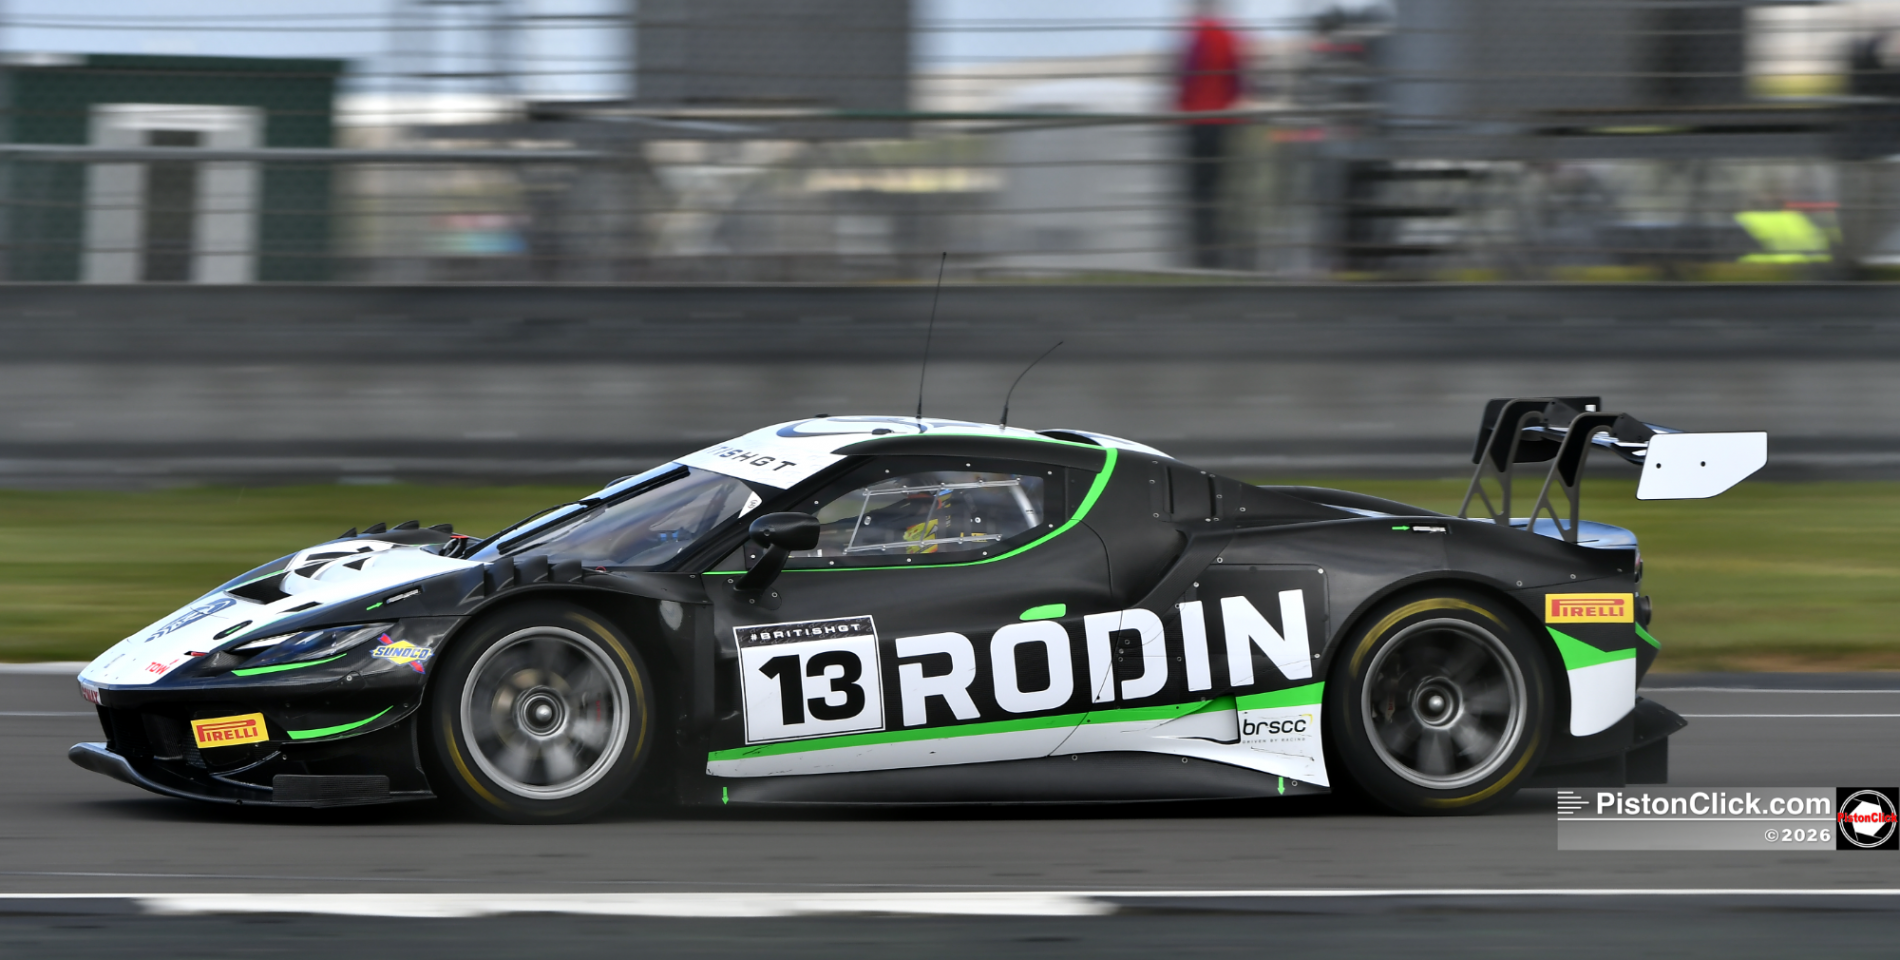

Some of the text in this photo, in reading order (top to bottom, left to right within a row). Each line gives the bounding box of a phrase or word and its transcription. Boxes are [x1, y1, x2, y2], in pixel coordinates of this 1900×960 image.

[1551, 598, 1625, 617] PIRELLI
[750, 623, 861, 641] #BRITISHGT
[375, 646, 430, 659] SUNOCO
[145, 661, 171, 675] TOW
[758, 650, 866, 726] 13
[196, 718, 259, 743] PIRELLI
[1242, 718, 1307, 736] brscc
